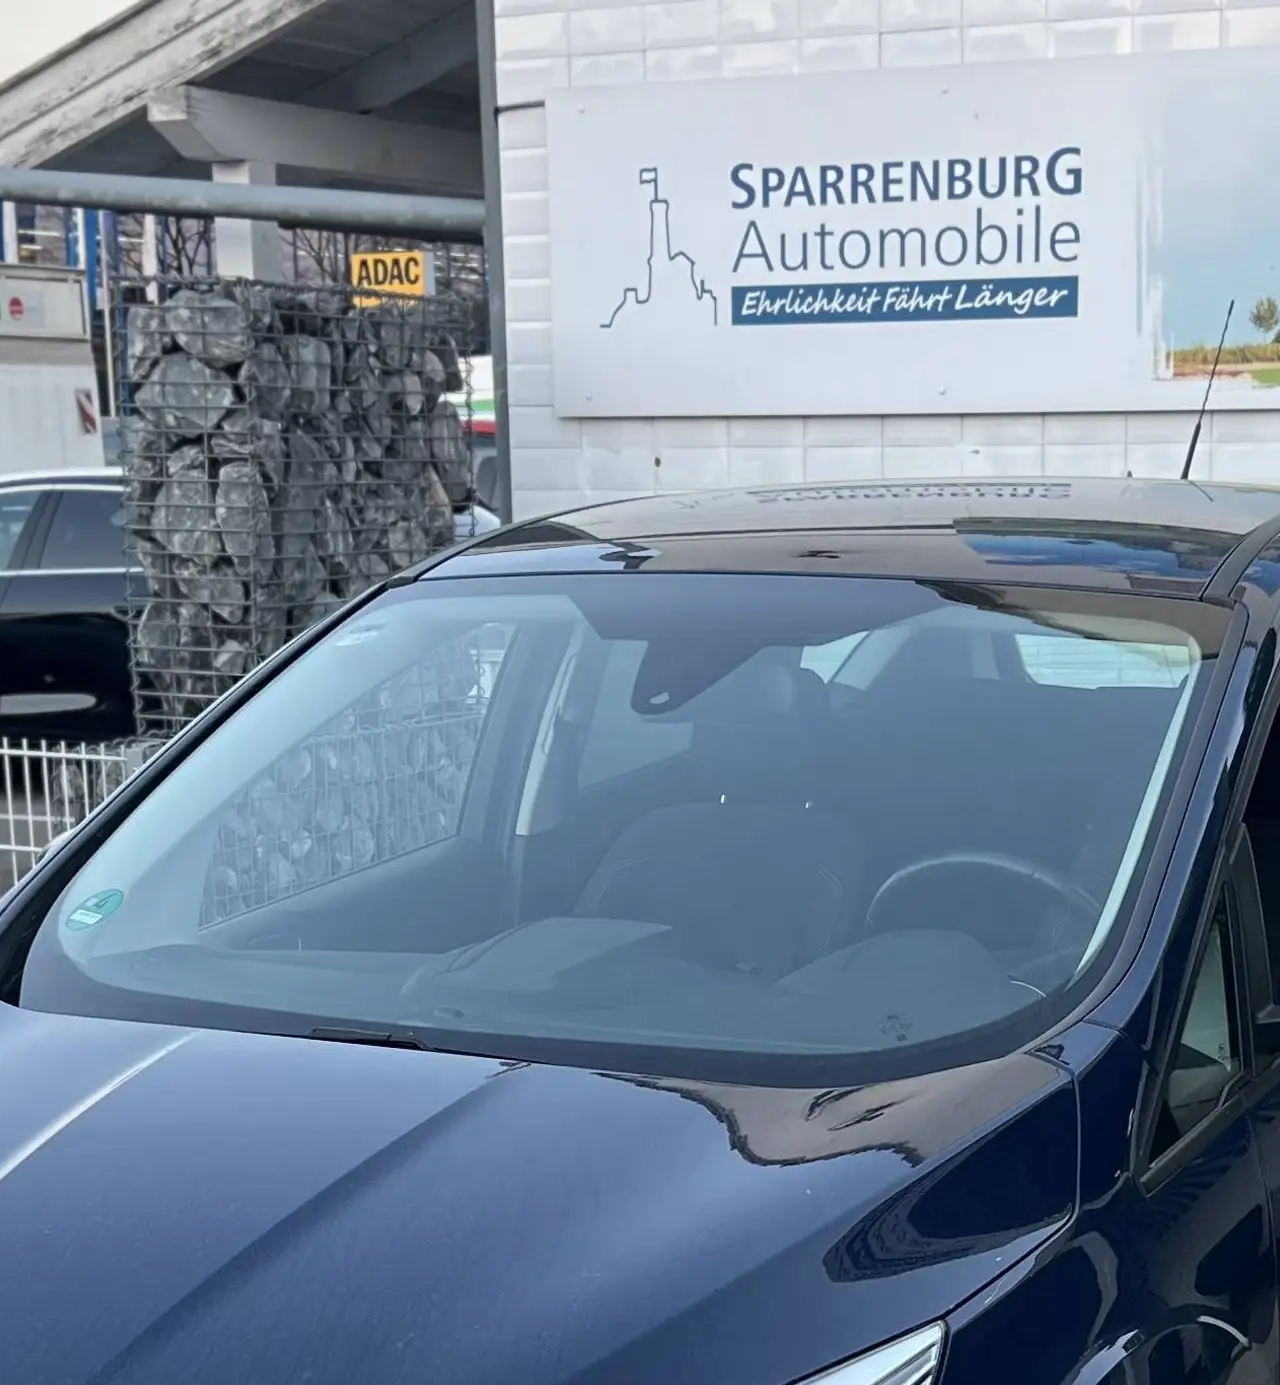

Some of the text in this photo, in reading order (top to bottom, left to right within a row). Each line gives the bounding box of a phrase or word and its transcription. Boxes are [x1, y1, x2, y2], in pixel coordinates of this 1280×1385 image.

[730, 146, 1083, 210] SPARRENBURG
[731, 204, 1081, 273] Automobile
[357, 256, 420, 288] ADAC
[741, 283, 1068, 316] Ehrlichkeit Fährt Länger
